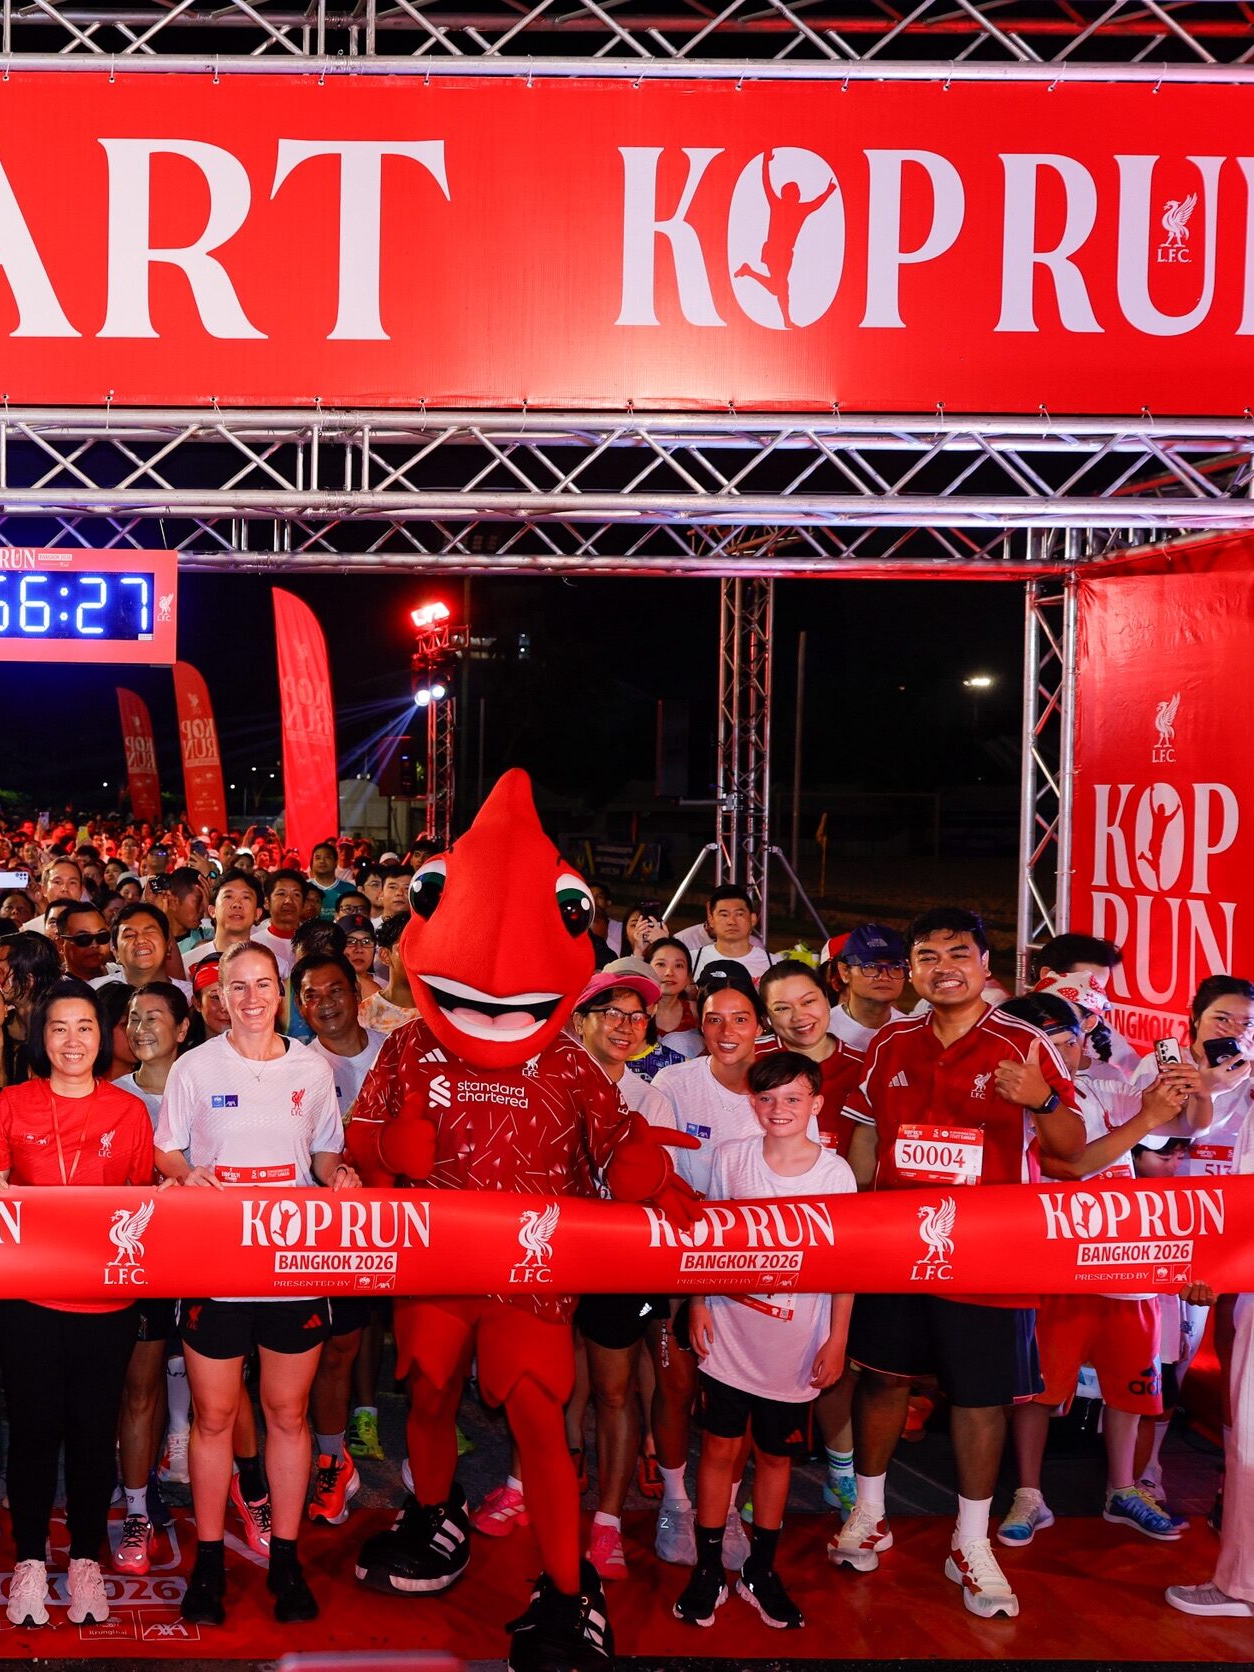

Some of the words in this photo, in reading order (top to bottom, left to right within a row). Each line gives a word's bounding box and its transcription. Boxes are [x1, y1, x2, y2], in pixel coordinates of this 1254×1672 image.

[614, 146, 966, 331] KOP
[993, 153, 1254, 336] RU
[1156, 248, 1192, 263] L.F.C.
[1091, 782, 1240, 894] KOP
[1104, 1010, 1174, 1044] ANGKOK
[457, 1080, 525, 1098] standard
[457, 1090, 529, 1109] chartered
[900, 1143, 966, 1169] 50004
[1037, 1191, 1131, 1240] KOP
[1133, 1189, 1225, 1238] RUN
[240, 1200, 332, 1248] KOP
[339, 1201, 431, 1248] RUN
[737, 1202, 835, 1246] RUN
[683, 1254, 758, 1270] BANGKOK
[759, 1253, 800, 1269] 2026
[1081, 1245, 1152, 1262] BANGKOK
[1153, 1243, 1190, 1260] 2026
[278, 1255, 352, 1271] BANGKOK
[354, 1255, 394, 1271] 2026
[103, 1268, 148, 1285] L.F.C.
[509, 1268, 553, 1284] L.F.C.
[910, 1265, 954, 1281] L.F.C.
[1074, 1272, 1134, 1281] PRESENTED
[1135, 1271, 1149, 1280] BY
[273, 1280, 336, 1288] PRESENTED
[337, 1280, 351, 1288] BY
[100, 1575, 183, 1602] 026
[144, 1622, 186, 1637] AXA
